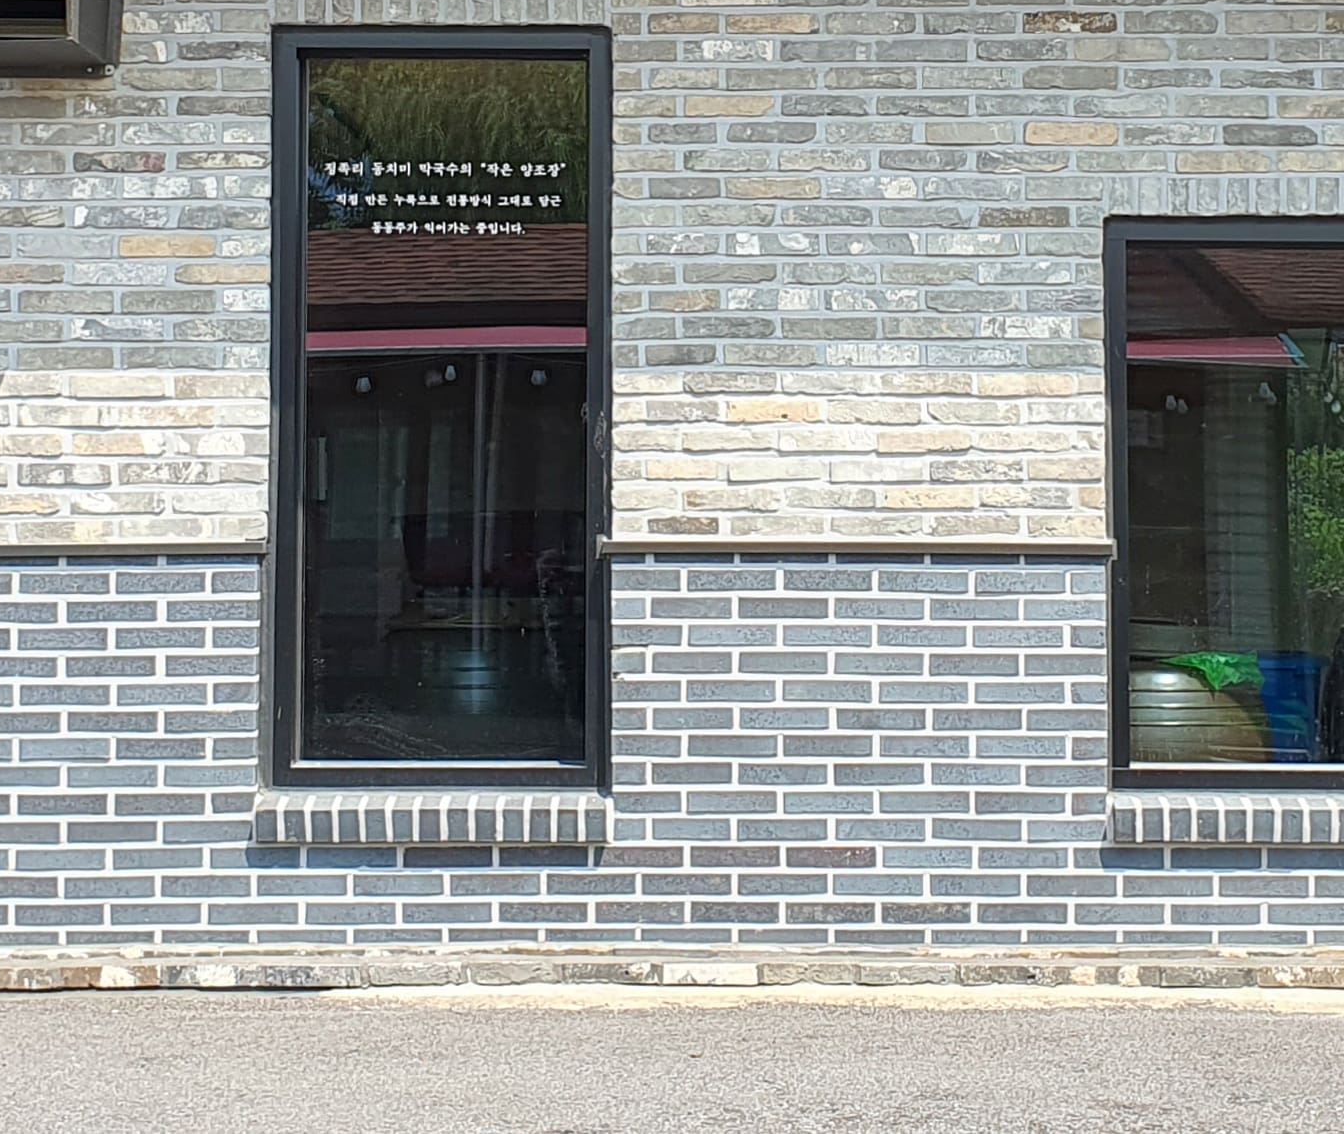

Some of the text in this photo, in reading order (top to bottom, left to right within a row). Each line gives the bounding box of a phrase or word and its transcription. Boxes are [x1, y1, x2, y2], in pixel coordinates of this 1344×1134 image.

[371, 161, 411, 177] 동치미
[418, 161, 472, 177] 막국수의
[335, 193, 562, 208] 직접 만든 누룩으로 전통방식 그대로 담근
[371, 221, 526, 235] 동동주가 익어가는 중입니다.
